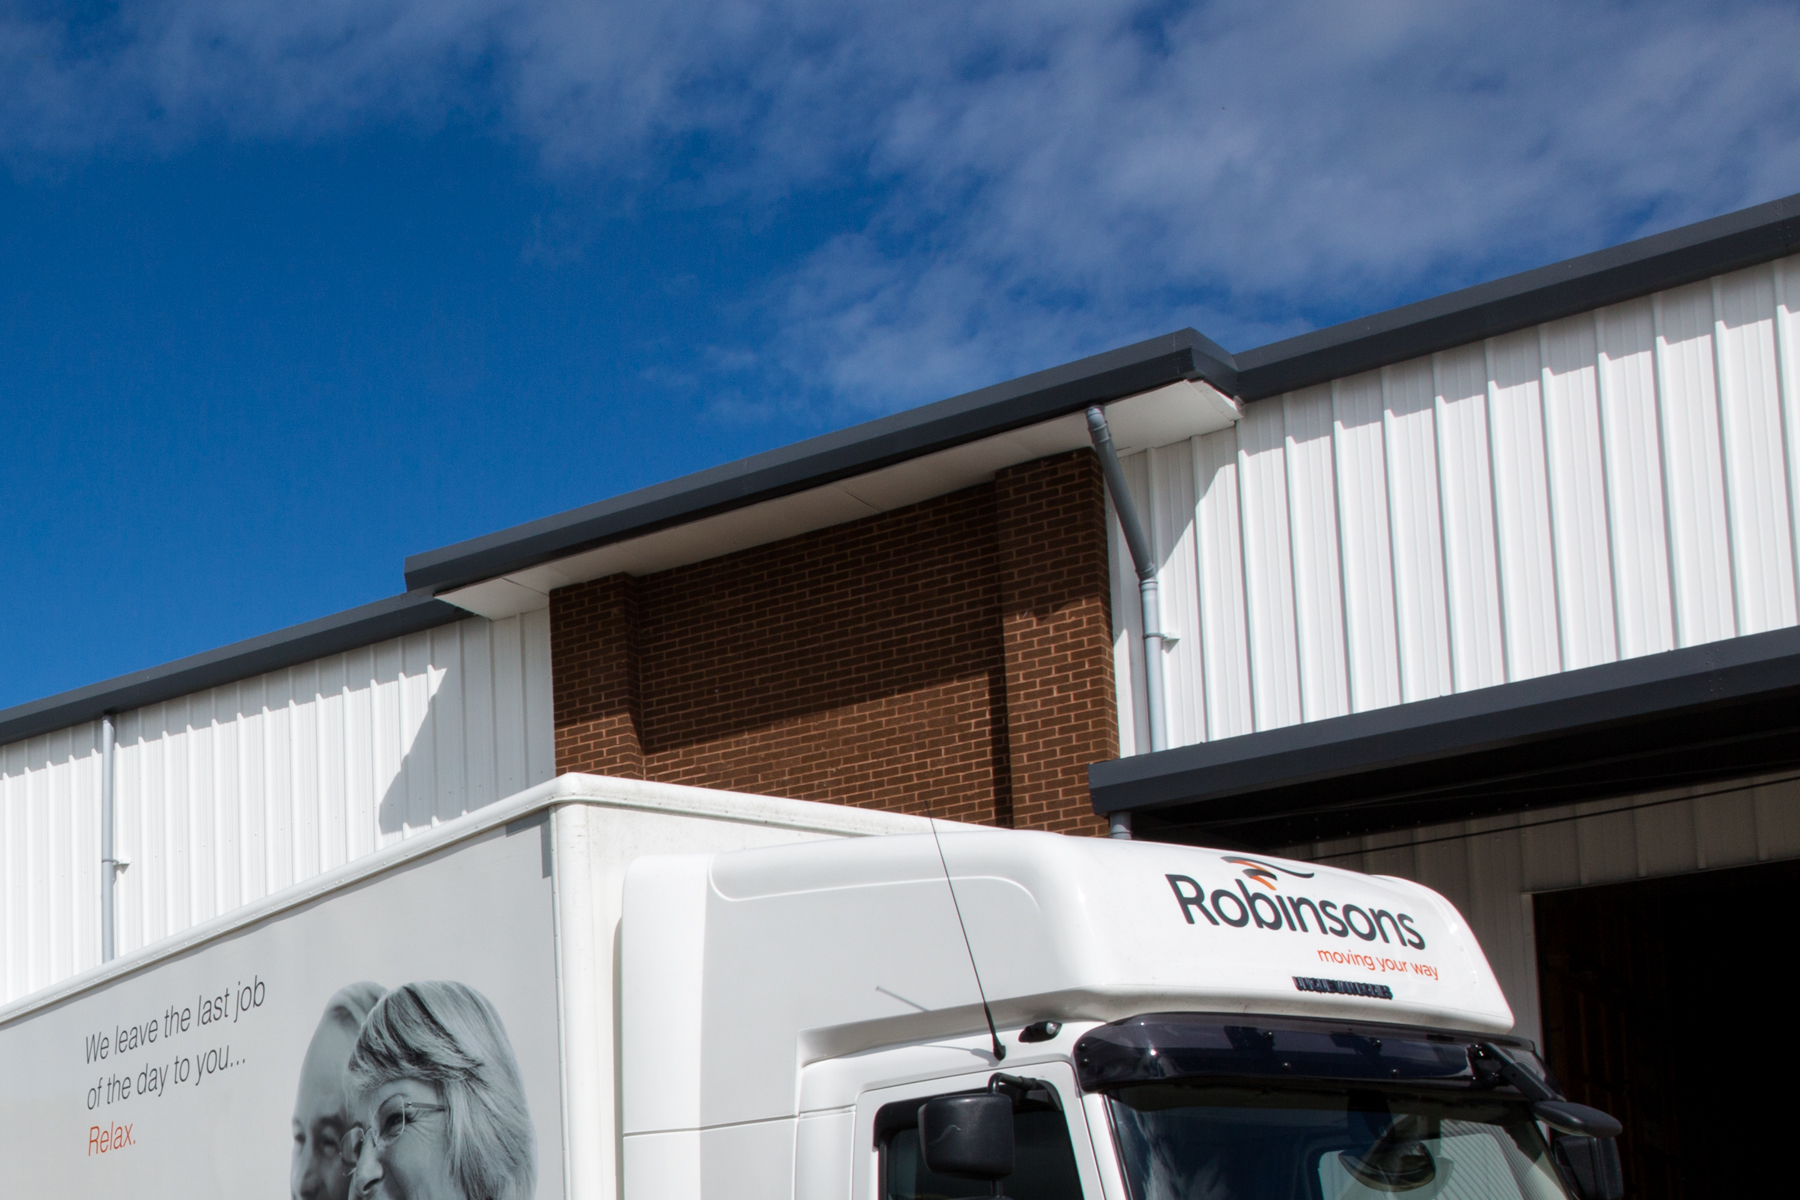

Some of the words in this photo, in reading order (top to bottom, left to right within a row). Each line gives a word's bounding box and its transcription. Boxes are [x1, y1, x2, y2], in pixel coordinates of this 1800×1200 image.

[1165, 873, 1426, 950] Robinsons
[1317, 949, 1376, 971] moving
[1375, 956, 1408, 973] your
[1410, 964, 1439, 981] way
[85, 1031, 110, 1064] We
[114, 1025, 159, 1055] leave
[164, 1005, 191, 1038] the
[197, 988, 230, 1027] last
[233, 975, 266, 1023] job
[87, 1077, 103, 1110] of
[106, 1073, 132, 1105] the
[137, 1063, 169, 1097] day
[174, 1055, 191, 1084] to
[195, 1045, 246, 1086] you...
[88, 1121, 136, 1157] Relax.
